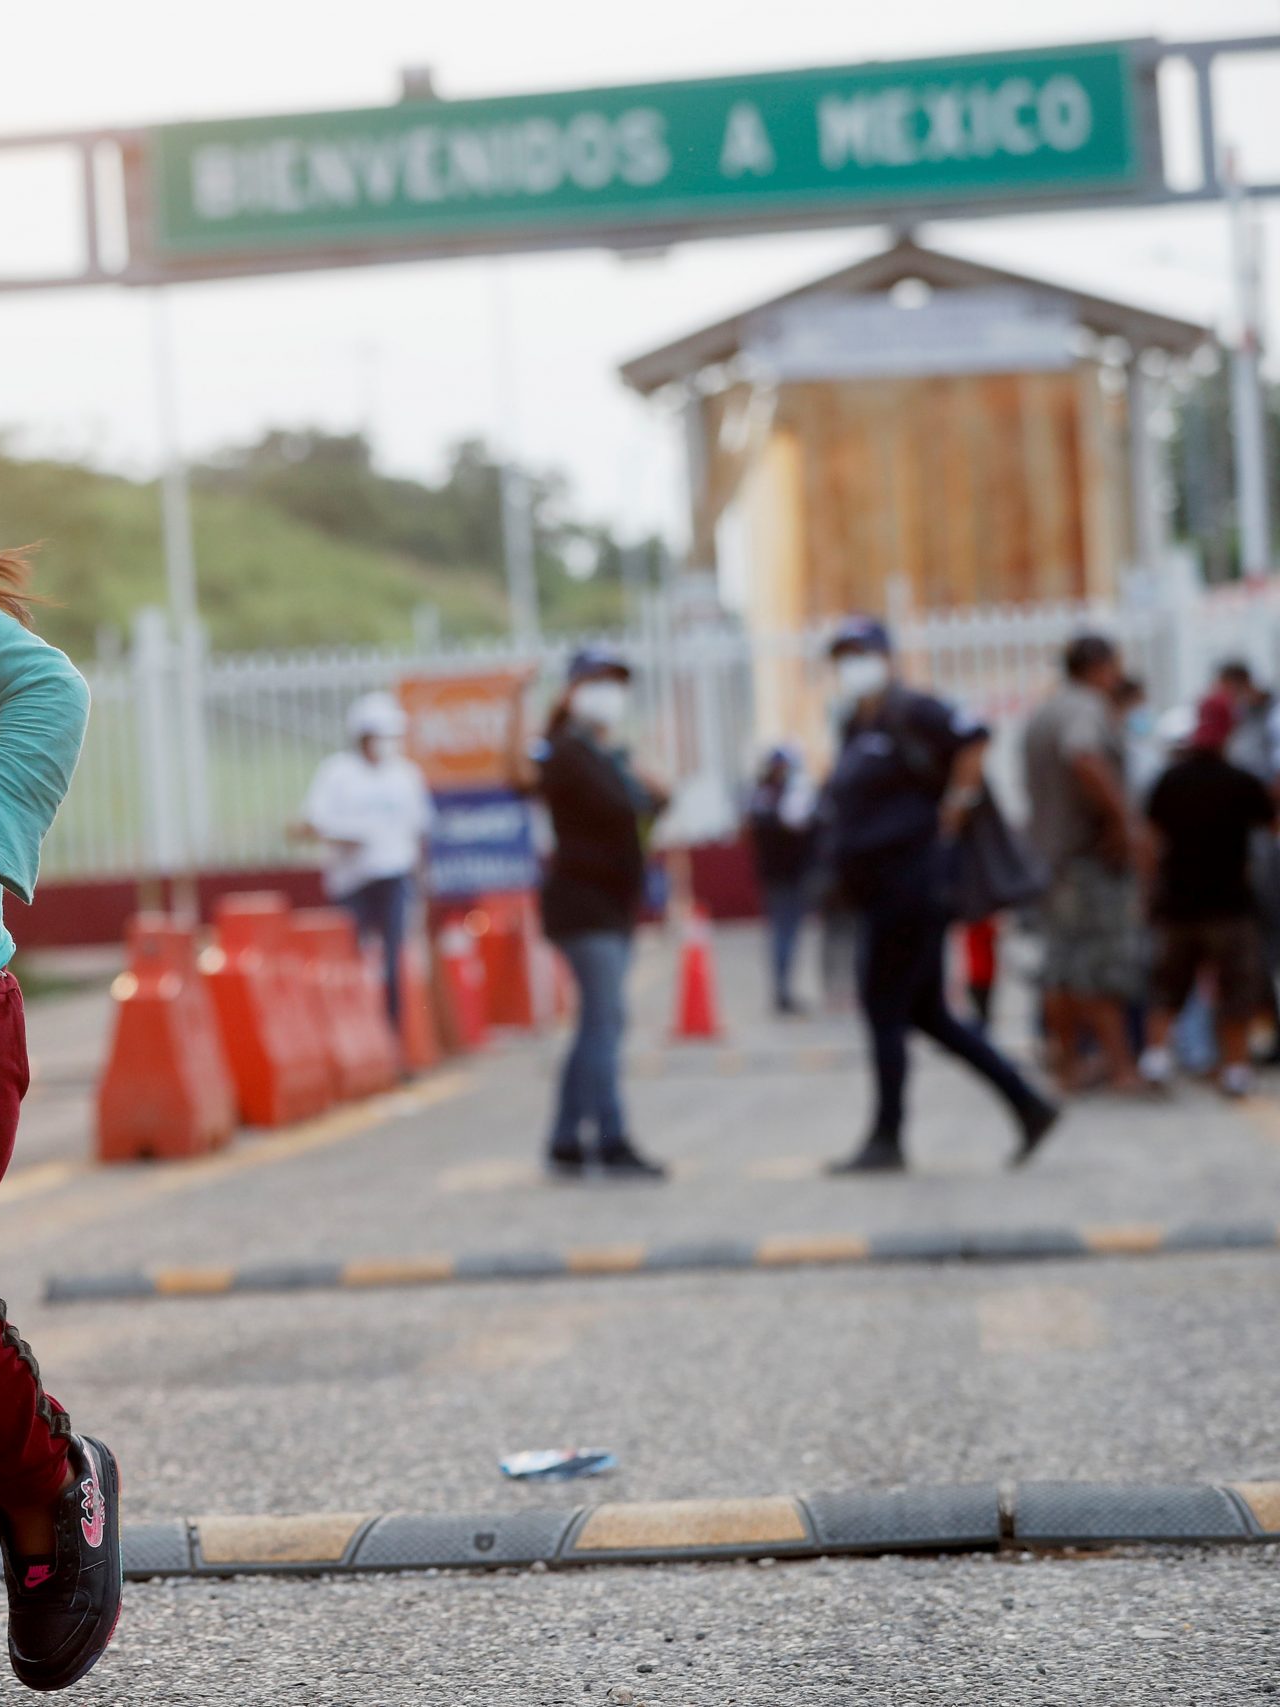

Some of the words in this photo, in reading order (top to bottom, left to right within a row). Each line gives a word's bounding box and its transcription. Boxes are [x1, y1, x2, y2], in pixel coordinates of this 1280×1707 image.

[192, 107, 671, 219] BIENVENIDOS
[720, 99, 775, 178] A
[817, 73, 1091, 170] MEXICO
